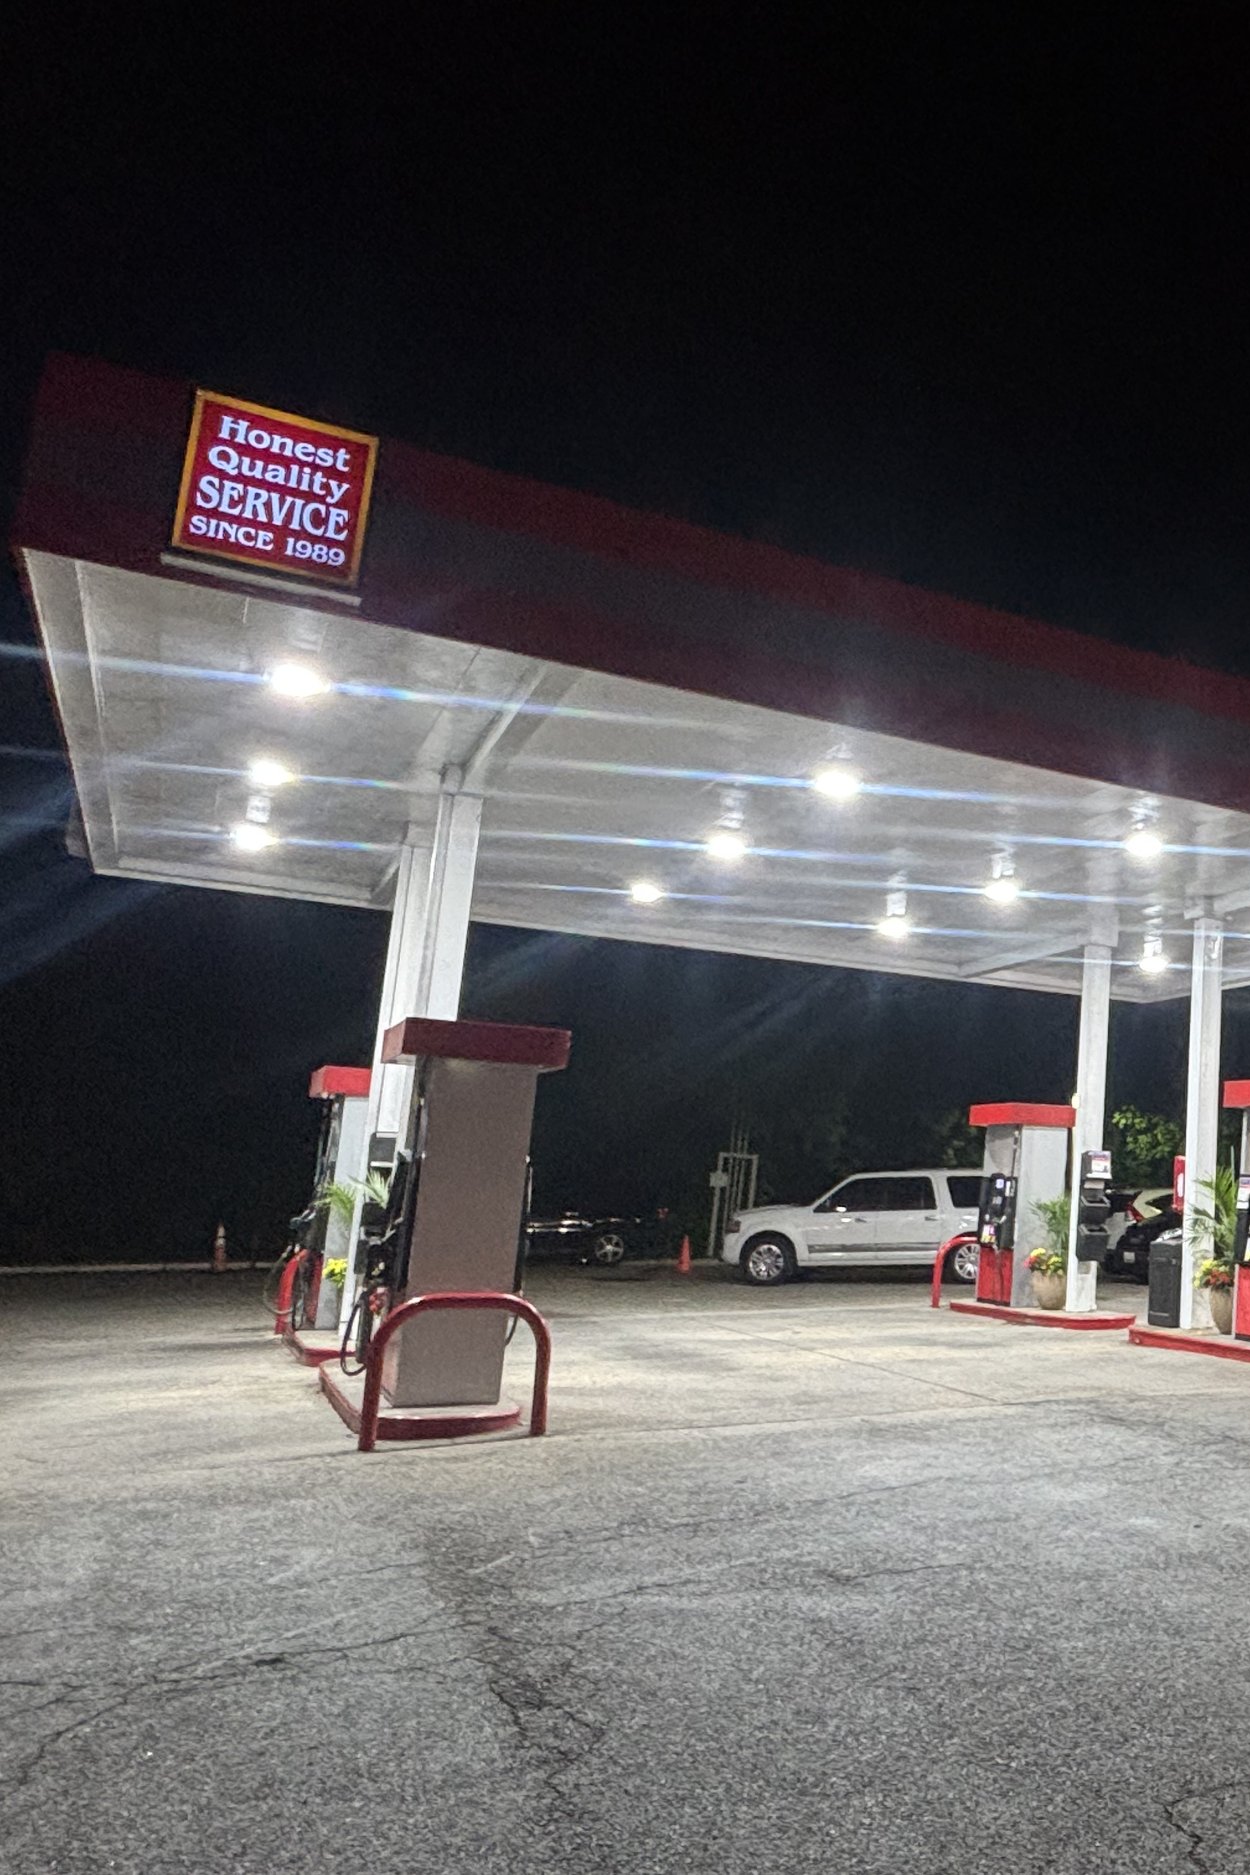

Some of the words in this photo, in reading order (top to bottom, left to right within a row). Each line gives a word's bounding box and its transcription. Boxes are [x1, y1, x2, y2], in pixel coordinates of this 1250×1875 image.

[219, 416, 351, 472] Honest
[208, 446, 350, 504] Quality
[197, 476, 349, 541] SERVICE
[190, 516, 274, 550] SINCE
[285, 538, 345, 567] 1989
